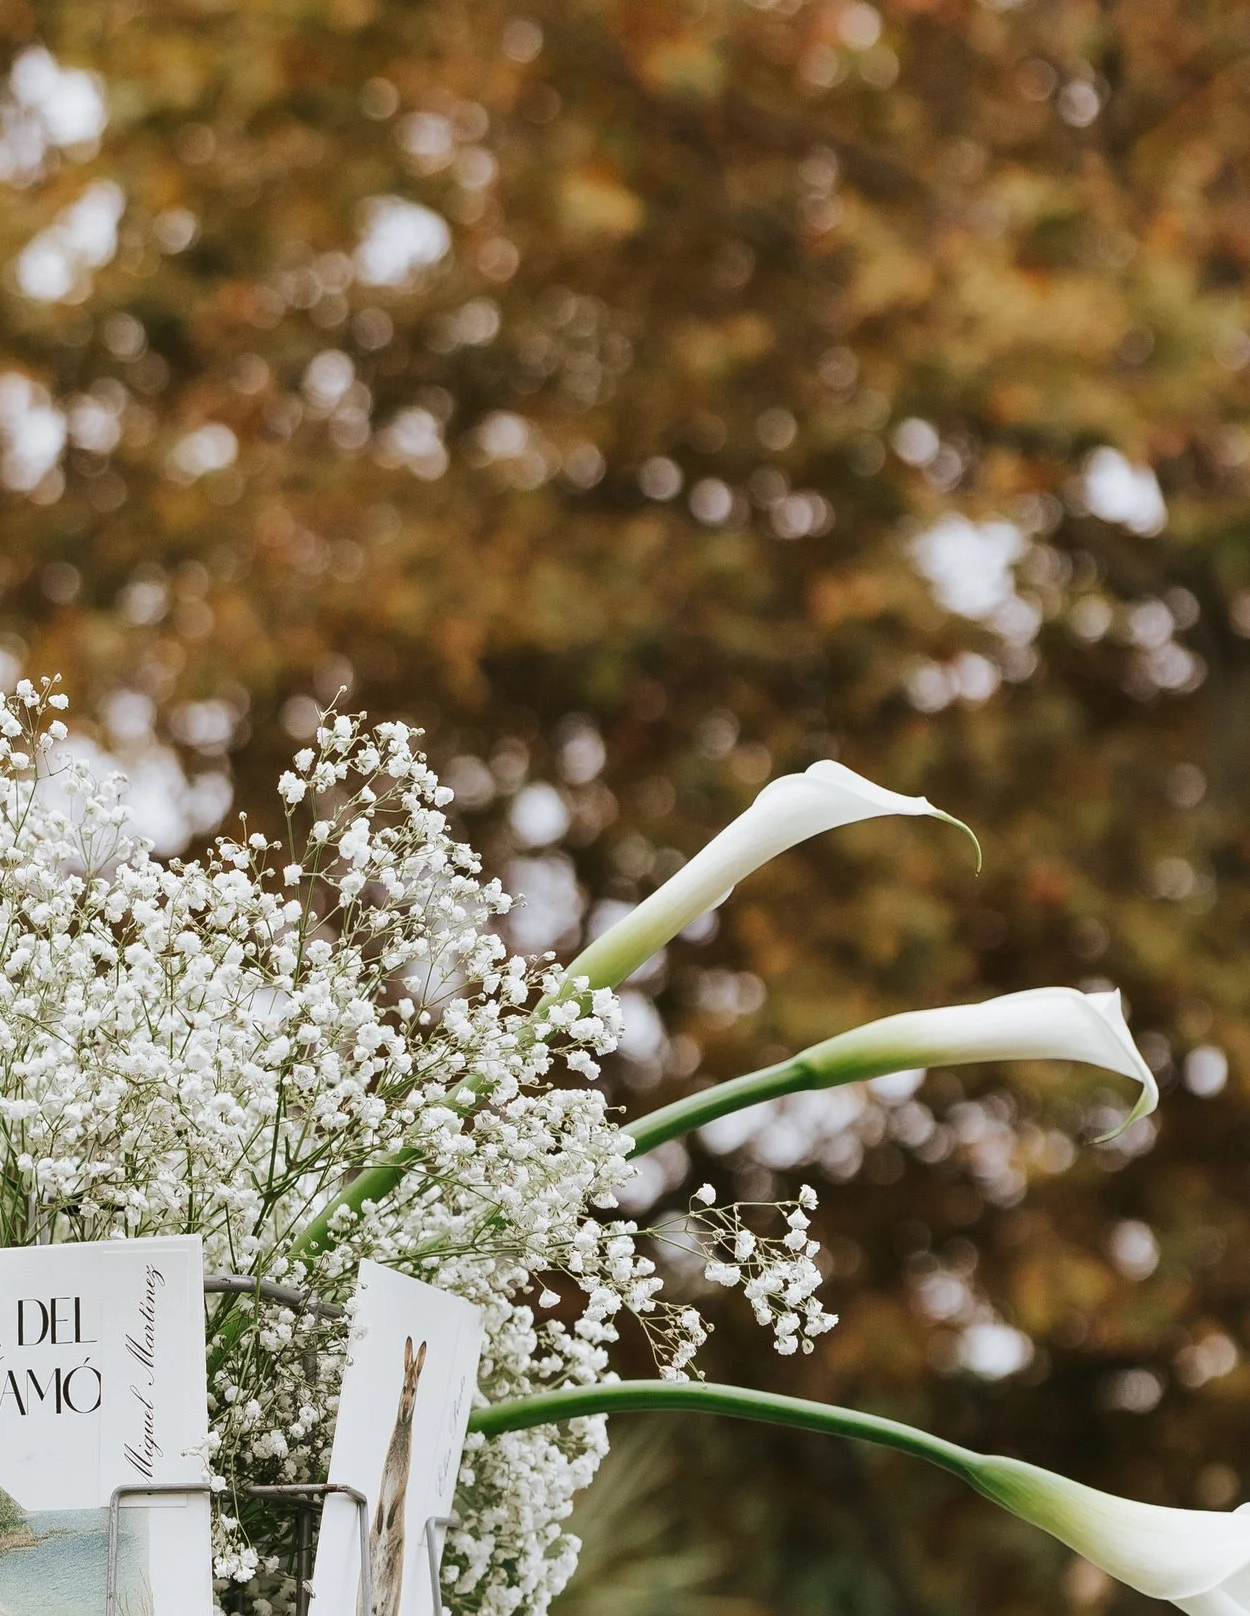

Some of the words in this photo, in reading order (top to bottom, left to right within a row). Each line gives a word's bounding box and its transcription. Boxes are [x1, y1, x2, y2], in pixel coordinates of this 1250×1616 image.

[17, 1296, 98, 1346] DEL
[125, 1263, 166, 1386] Martínez
[124, 1384, 164, 1484] Miguel
